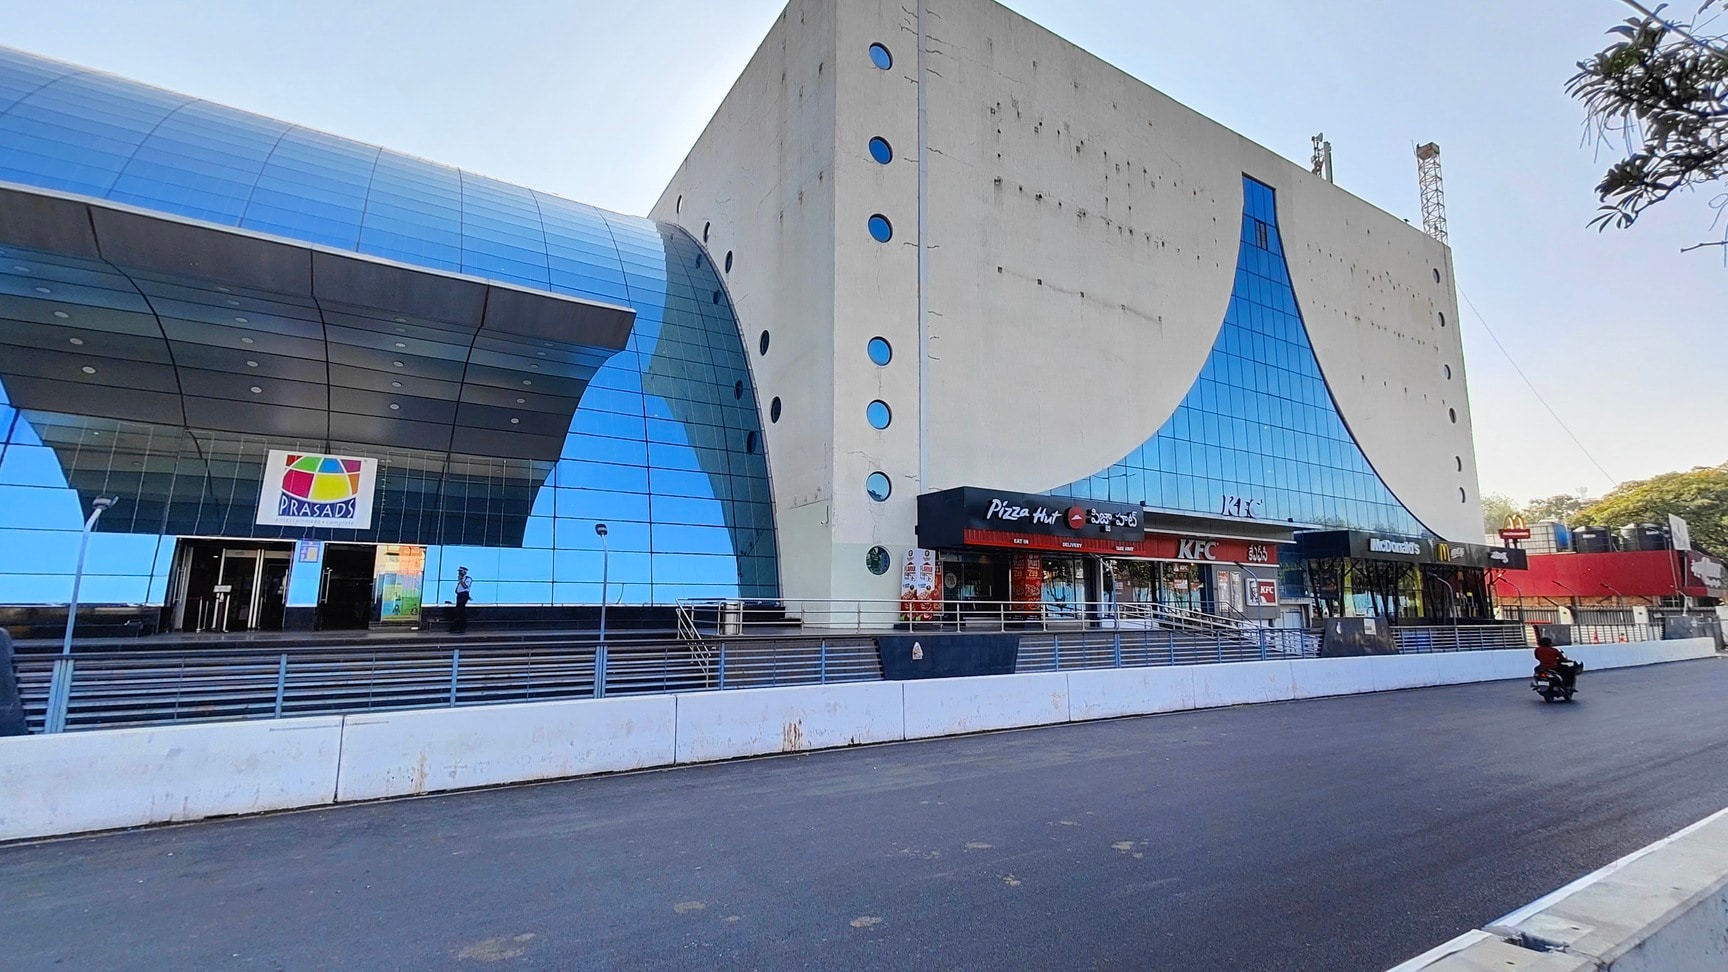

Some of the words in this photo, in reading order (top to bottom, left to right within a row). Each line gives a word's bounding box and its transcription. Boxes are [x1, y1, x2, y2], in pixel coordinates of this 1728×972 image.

[279, 495, 355, 518] PRASADS
[986, 498, 1029, 521] Pizza
[1033, 506, 1062, 525] Hut
[1221, 494, 1262, 519] KFC
[1178, 539, 1218, 560] KFC
[1370, 538, 1420, 555] McDonald's
[1260, 585, 1274, 594] KFC
